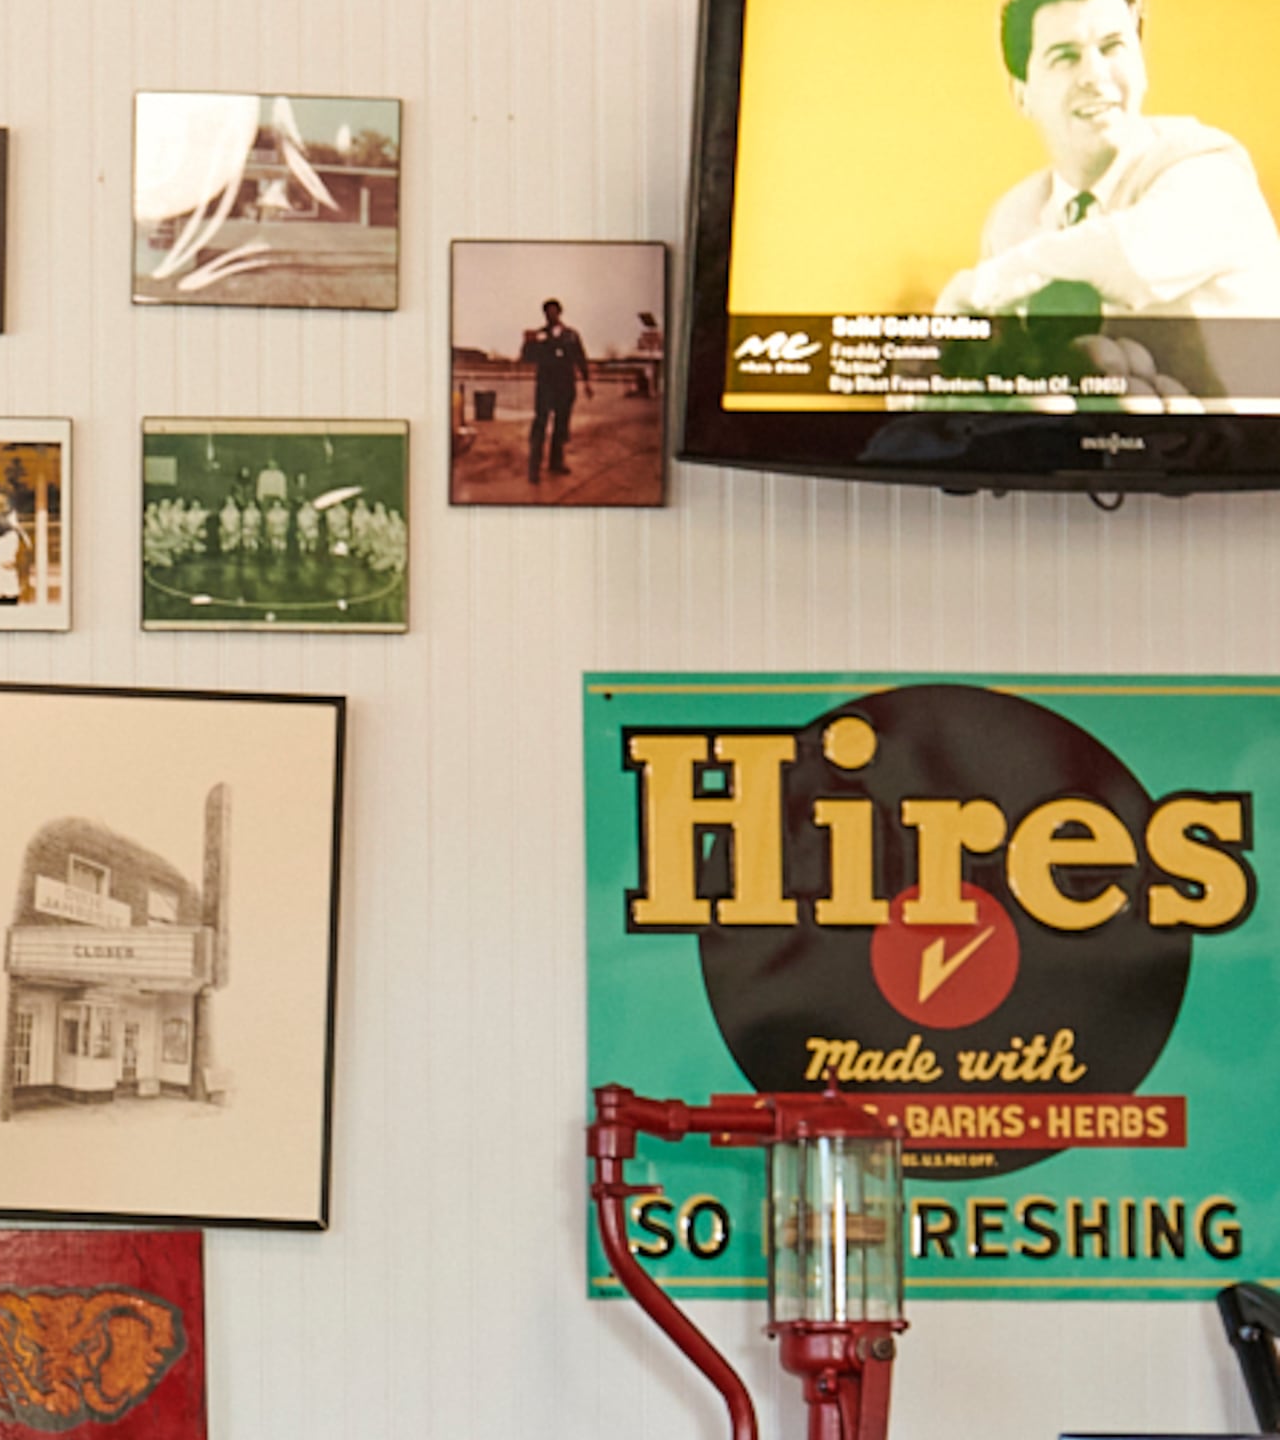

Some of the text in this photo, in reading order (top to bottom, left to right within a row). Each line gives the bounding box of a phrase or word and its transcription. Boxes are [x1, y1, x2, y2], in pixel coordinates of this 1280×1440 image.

[625, 713, 1253, 933] Hires
[804, 1028, 1089, 1084] Made with
[904, 1105, 1169, 1139] BARKS HERBS
[627, 1193, 731, 1261] SO
